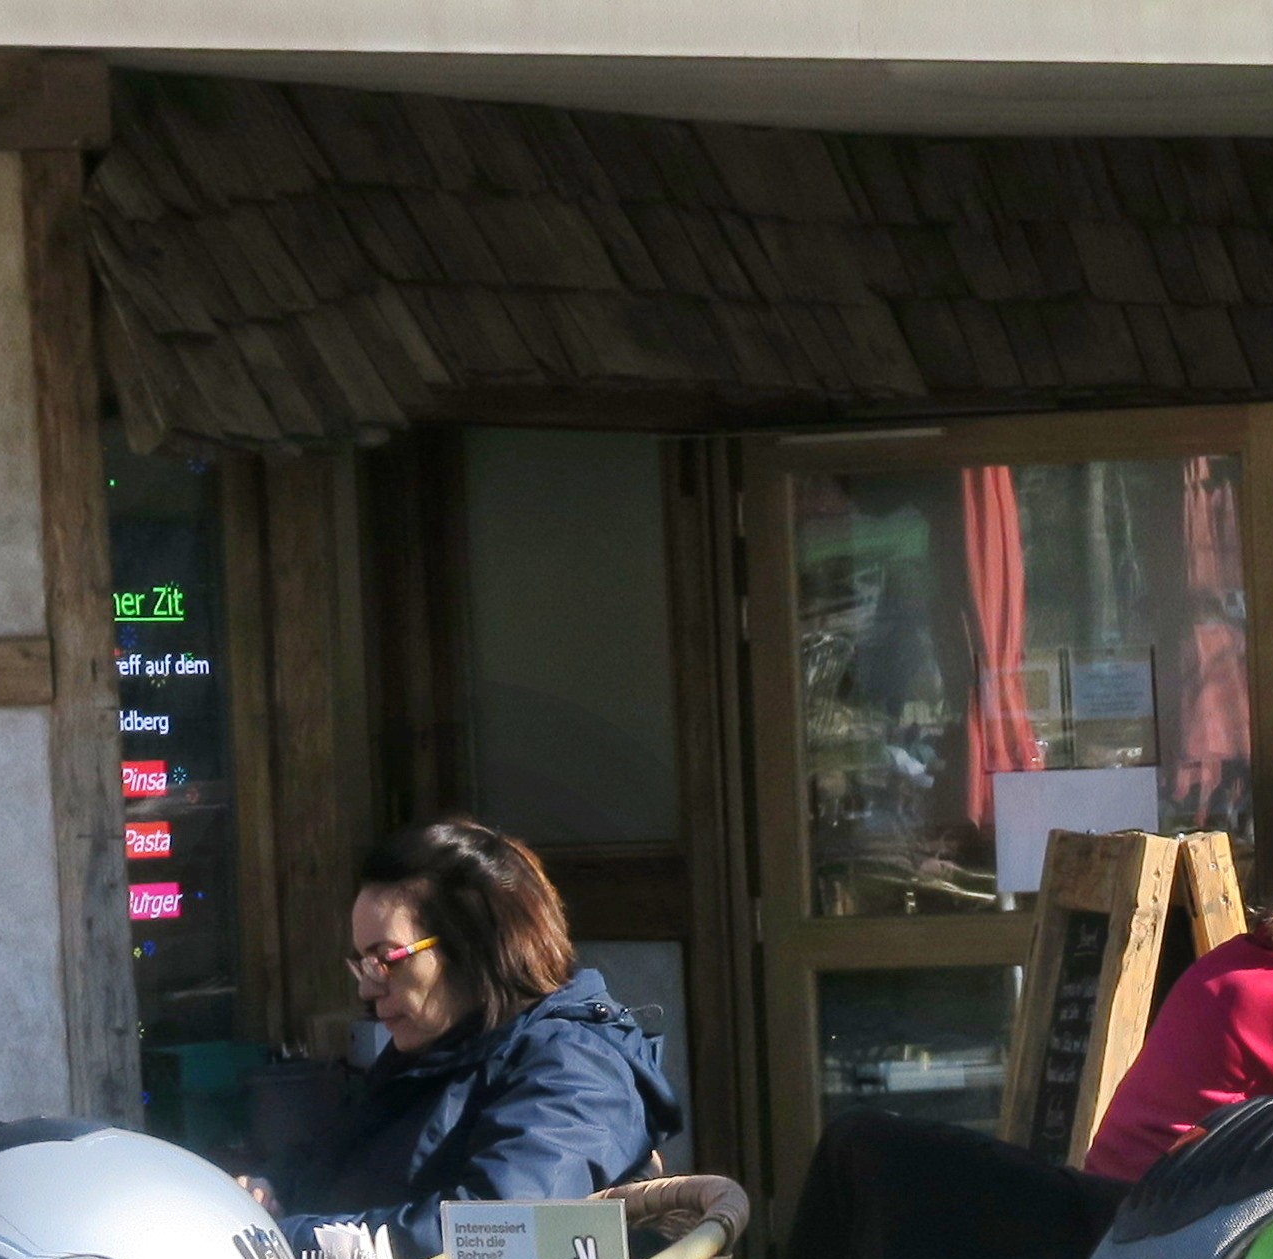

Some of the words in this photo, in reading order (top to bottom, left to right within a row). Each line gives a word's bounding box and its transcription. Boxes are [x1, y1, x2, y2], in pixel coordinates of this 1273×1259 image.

[153, 586, 184, 616] Zit
[116, 653, 142, 676] eff
[145, 653, 172, 676] auf
[175, 653, 210, 675] dem
[122, 768, 167, 792] Pinsa
[125, 829, 171, 852] Pasta
[129, 892, 183, 919] urger
[454, 1221, 527, 1234] Interessiert
[456, 1235, 485, 1248] Dich
[486, 1235, 506, 1248] die
